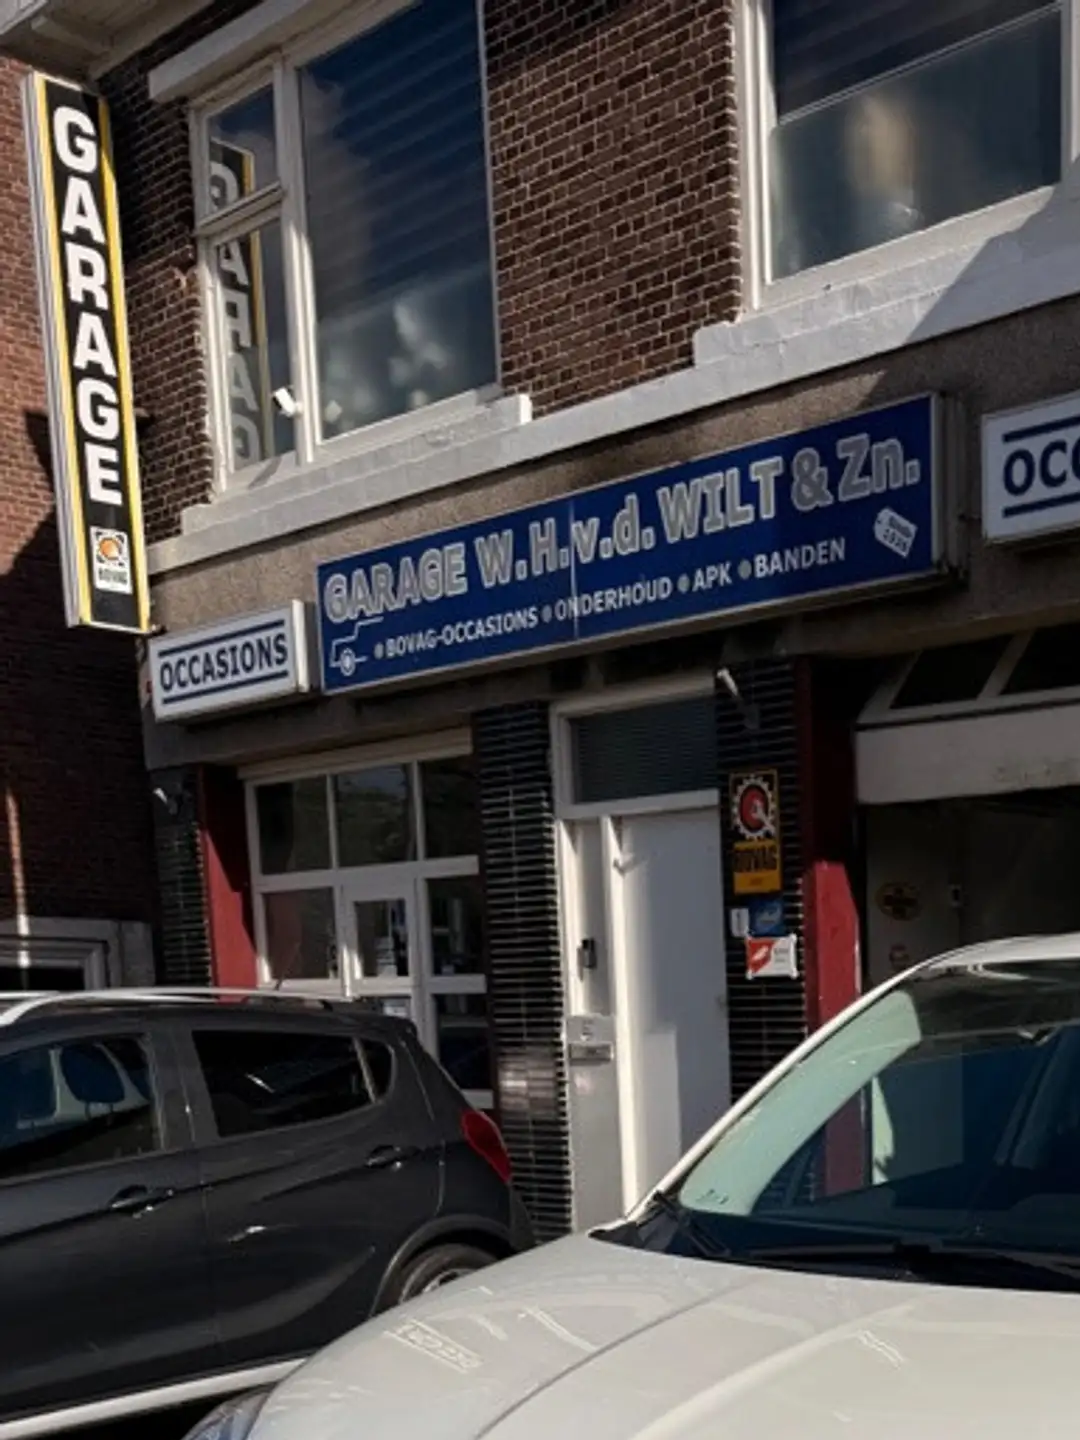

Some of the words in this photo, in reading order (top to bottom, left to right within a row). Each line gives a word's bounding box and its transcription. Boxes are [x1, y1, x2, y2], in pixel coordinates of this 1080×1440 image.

[53, 105, 122, 505] GARAGE
[323, 541, 469, 624] GARAGE
[656, 456, 784, 544] WILT
[790, 447, 834, 512] &
[836, 432, 921, 502] Zn.
[555, 576, 673, 621] ONDERHOUD
[691, 561, 733, 593] APK
[754, 537, 846, 579] BANDEN
[160, 633, 288, 692] OCCASIONS
